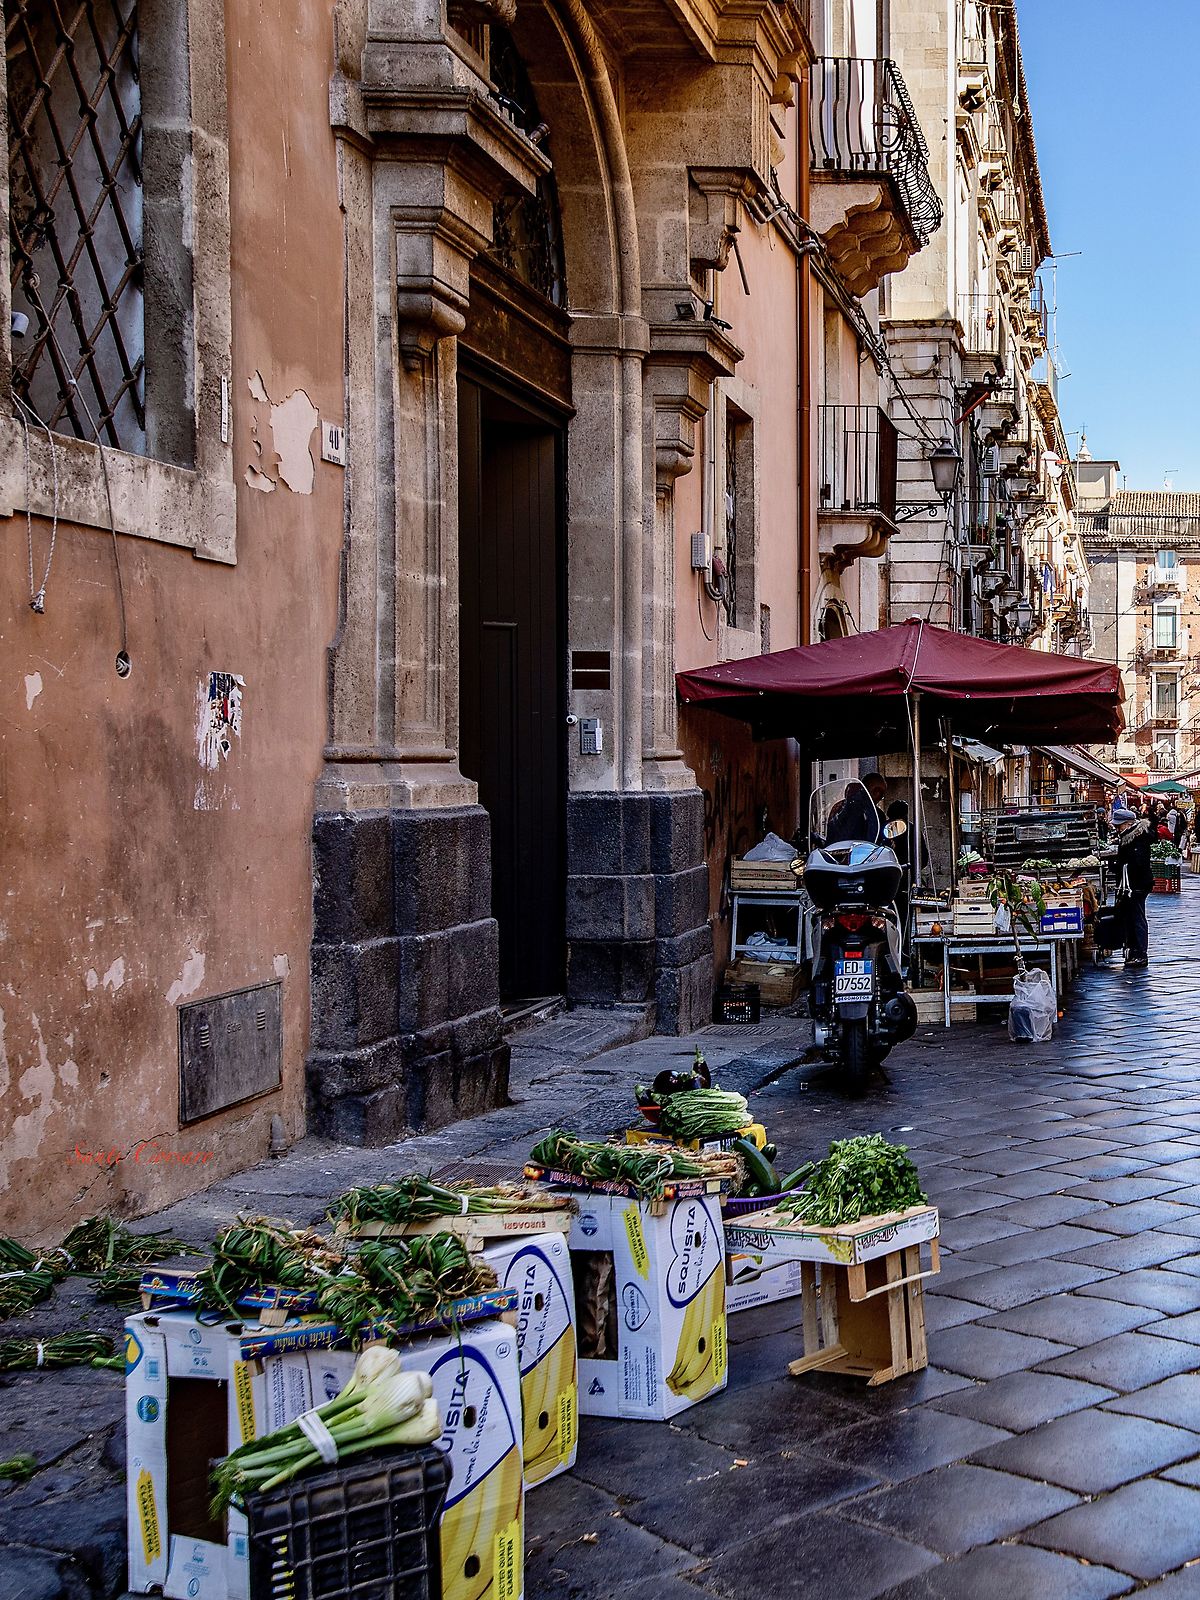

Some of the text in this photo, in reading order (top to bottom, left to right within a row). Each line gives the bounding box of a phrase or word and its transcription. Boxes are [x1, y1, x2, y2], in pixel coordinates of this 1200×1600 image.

[844, 961, 859, 974] ED
[837, 976, 871, 991] 07552
[503, 1220, 546, 1231] EUROAGRI
[678, 1205, 696, 1294] SQUISITA
[518, 1264, 537, 1354] QUISITA
